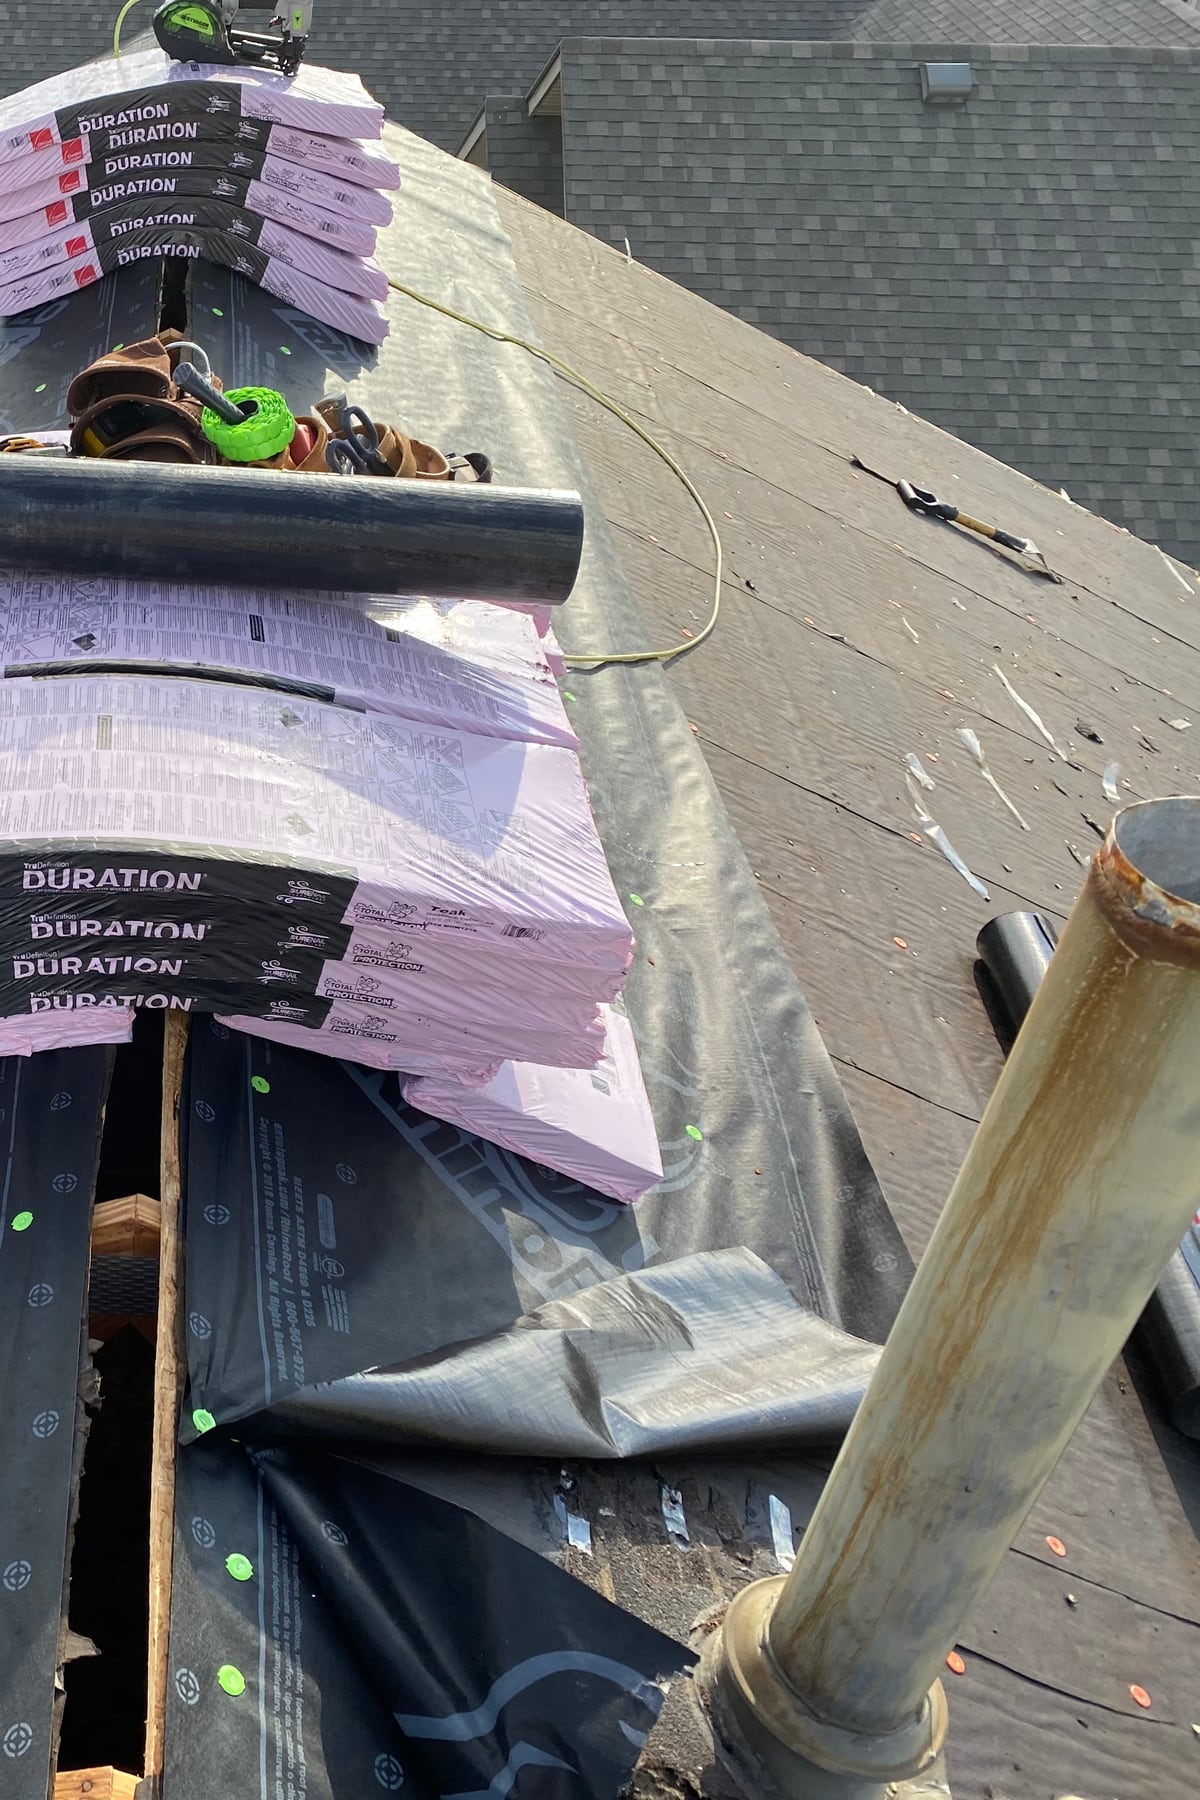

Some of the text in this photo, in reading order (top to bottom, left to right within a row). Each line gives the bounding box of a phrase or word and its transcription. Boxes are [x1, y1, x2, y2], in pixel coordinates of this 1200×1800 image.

[78, 103, 170, 134] DURATION
[108, 122, 198, 149] DURATION
[105, 152, 193, 175] DURATION
[90, 178, 177, 207] DURATION
[117, 244, 201, 266] DURATION
[22, 868, 202, 890] DURATION
[360, 906, 385, 917] TOTAL
[431, 905, 467, 917] Teak
[30, 920, 205, 941] DURATION
[359, 948, 383, 957] TOTAL
[13, 956, 183, 979] DURATION
[355, 956, 421, 972] PROTECTION
[331, 982, 354, 991] TOTAL
[29, 993, 192, 1014] DURATION
[326, 989, 392, 1006] PROTECTION
[332, 1026, 395, 1041] PROTECTION
[295, 1215, 306, 1250] ASTM
[267, 1295, 282, 1328] Rights
[283, 1300, 306, 1391] 800-567-9727
[297, 1744, 306, 1763] and
[287, 1771, 295, 1780] o
[299, 1765, 308, 1790] roof
